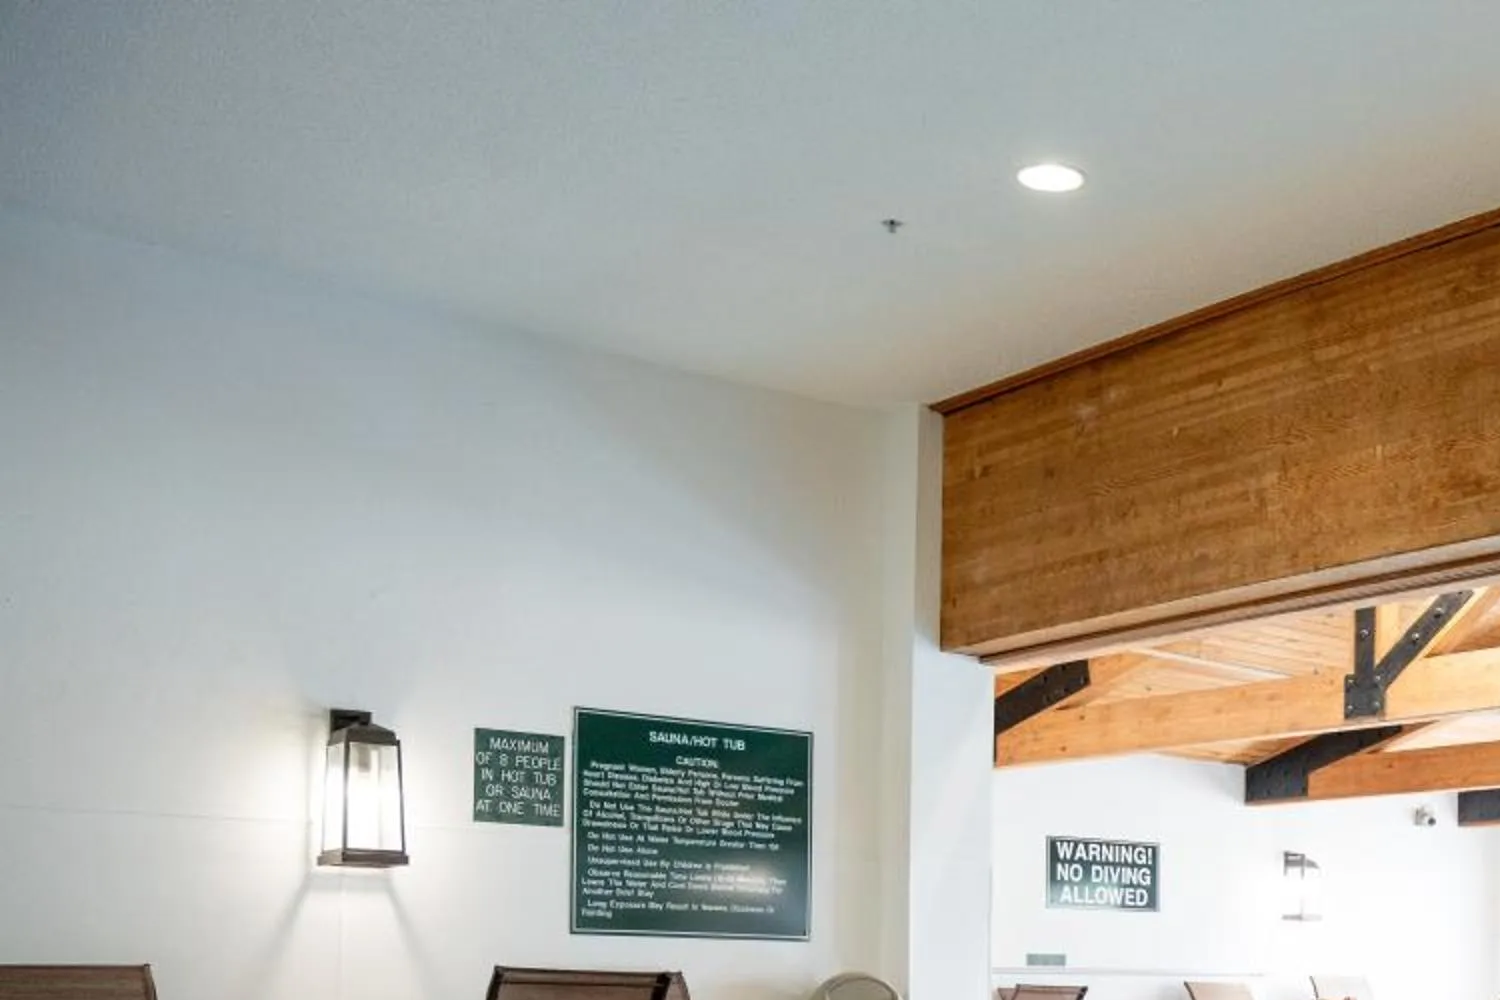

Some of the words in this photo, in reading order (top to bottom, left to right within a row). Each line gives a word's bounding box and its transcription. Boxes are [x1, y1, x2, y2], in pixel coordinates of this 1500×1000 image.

[490, 737, 549, 753] MAXIMUM
[649, 731, 718, 747] SAUNA/HOT
[722, 739, 745, 751] TUB
[476, 751, 492, 765] OF
[499, 753, 508, 767] 8
[515, 755, 561, 770] PEOPLE
[481, 768, 493, 781] IN
[501, 769, 525, 782] HOT
[533, 771, 557, 786] TUB
[486, 784, 503, 797] OR
[511, 786, 551, 800] SAUNA
[476, 800, 492, 812] AT
[499, 801, 524, 815] ONE
[532, 803, 560, 817] TIME
[1056, 841, 1153, 865] WARNING!
[1056, 863, 1083, 882] NO
[1091, 864, 1151, 886] DIVING
[1060, 885, 1149, 906] ALLOWED
